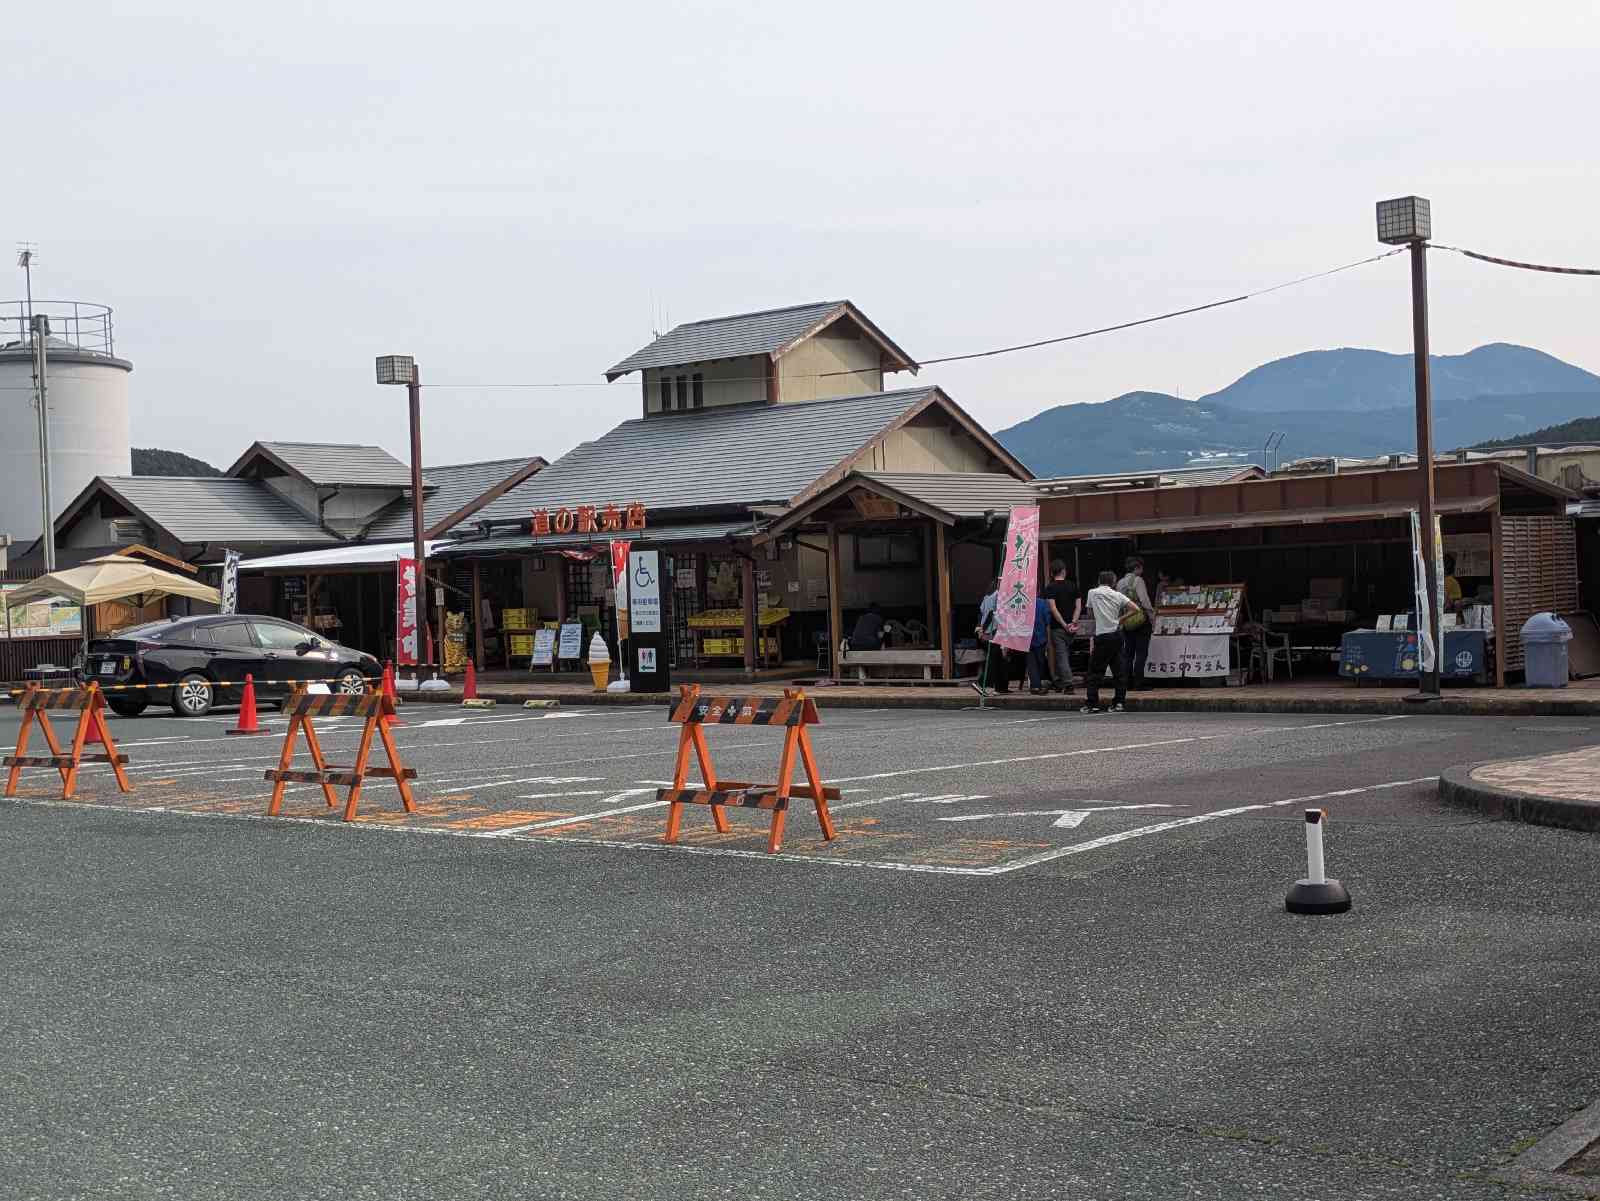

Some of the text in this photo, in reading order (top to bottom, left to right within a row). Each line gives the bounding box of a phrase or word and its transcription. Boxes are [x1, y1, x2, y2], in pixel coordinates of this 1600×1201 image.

[529, 501, 646, 535] 道の駅売店
